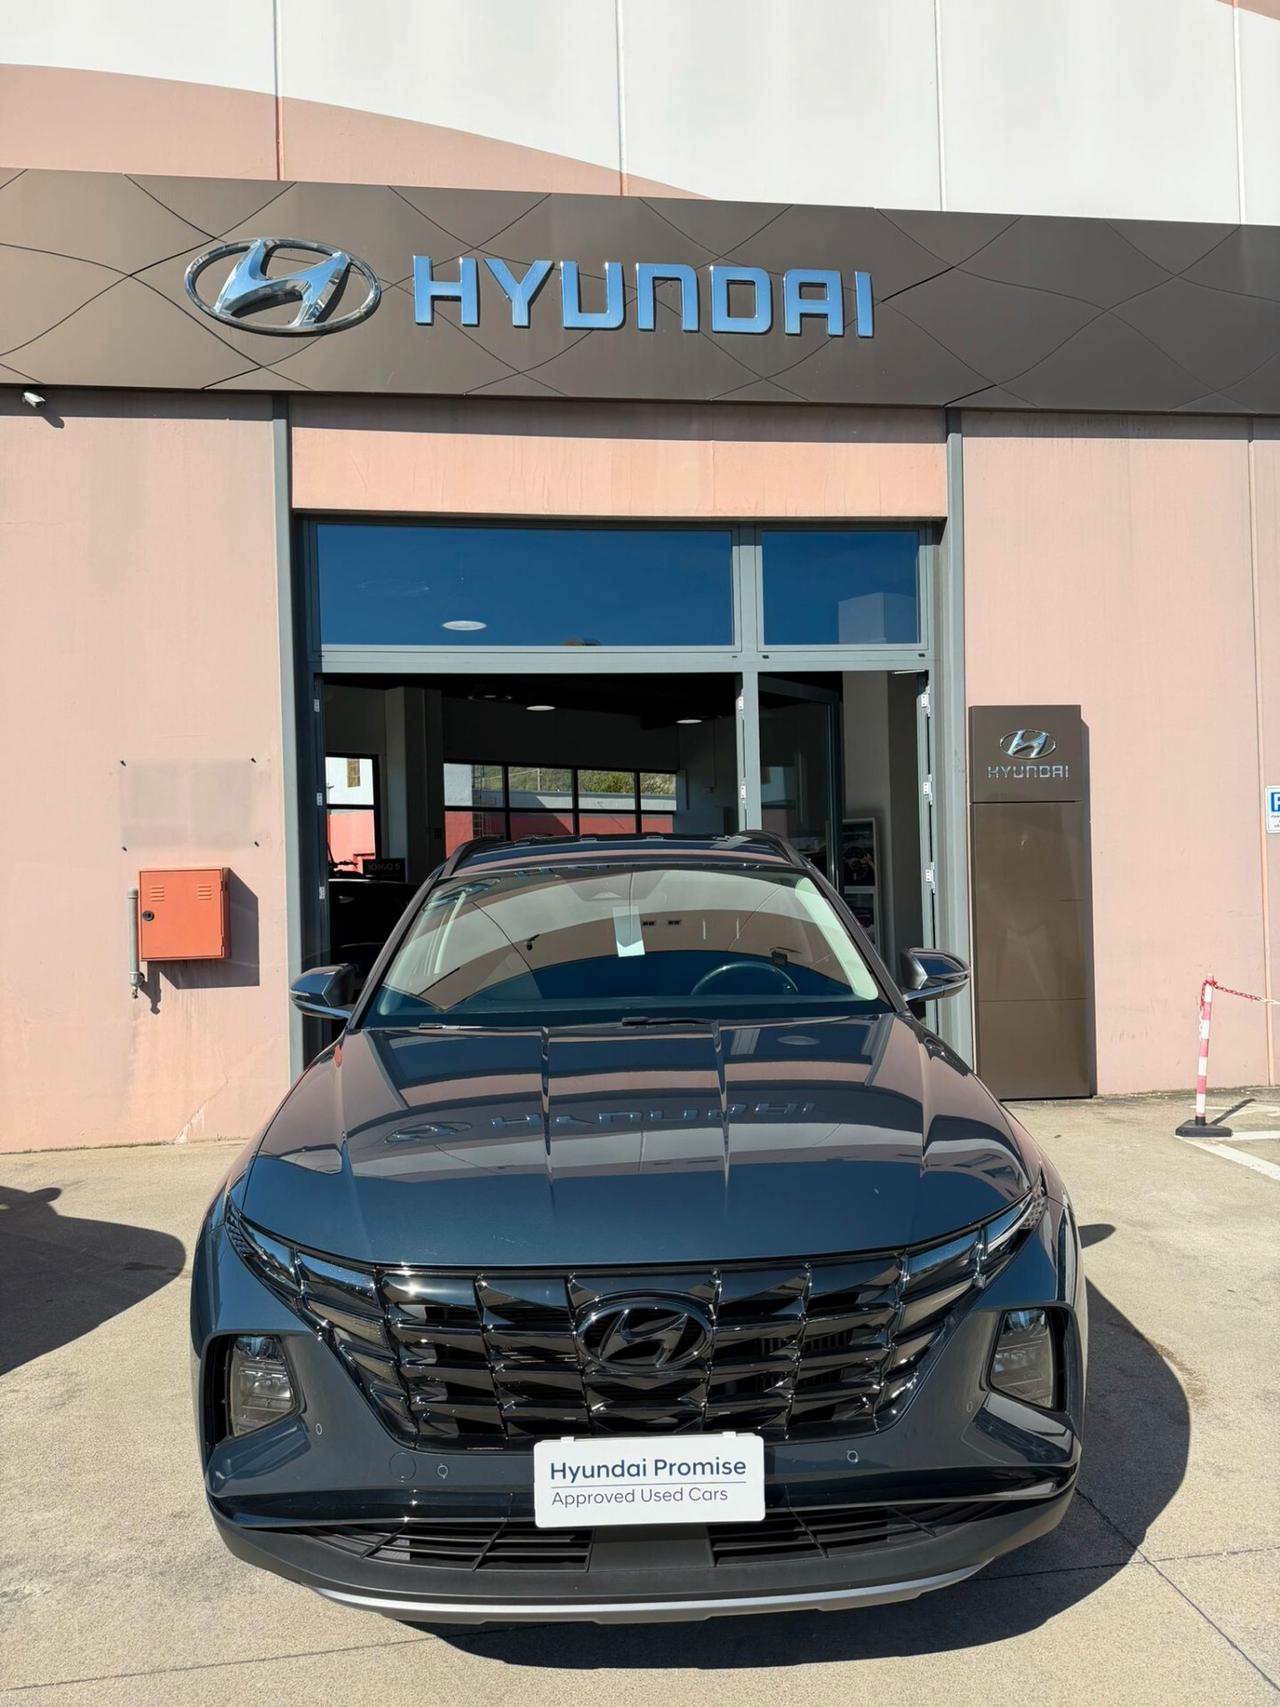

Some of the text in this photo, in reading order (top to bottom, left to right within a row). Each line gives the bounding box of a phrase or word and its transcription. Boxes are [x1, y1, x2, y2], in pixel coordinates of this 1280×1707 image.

[413, 255, 874, 337] HYUNDAI
[987, 765, 1069, 778] HYUNDAI
[550, 1457, 747, 1483] Hyundai Promise
[551, 1487, 728, 1508] Approved Used Cars
